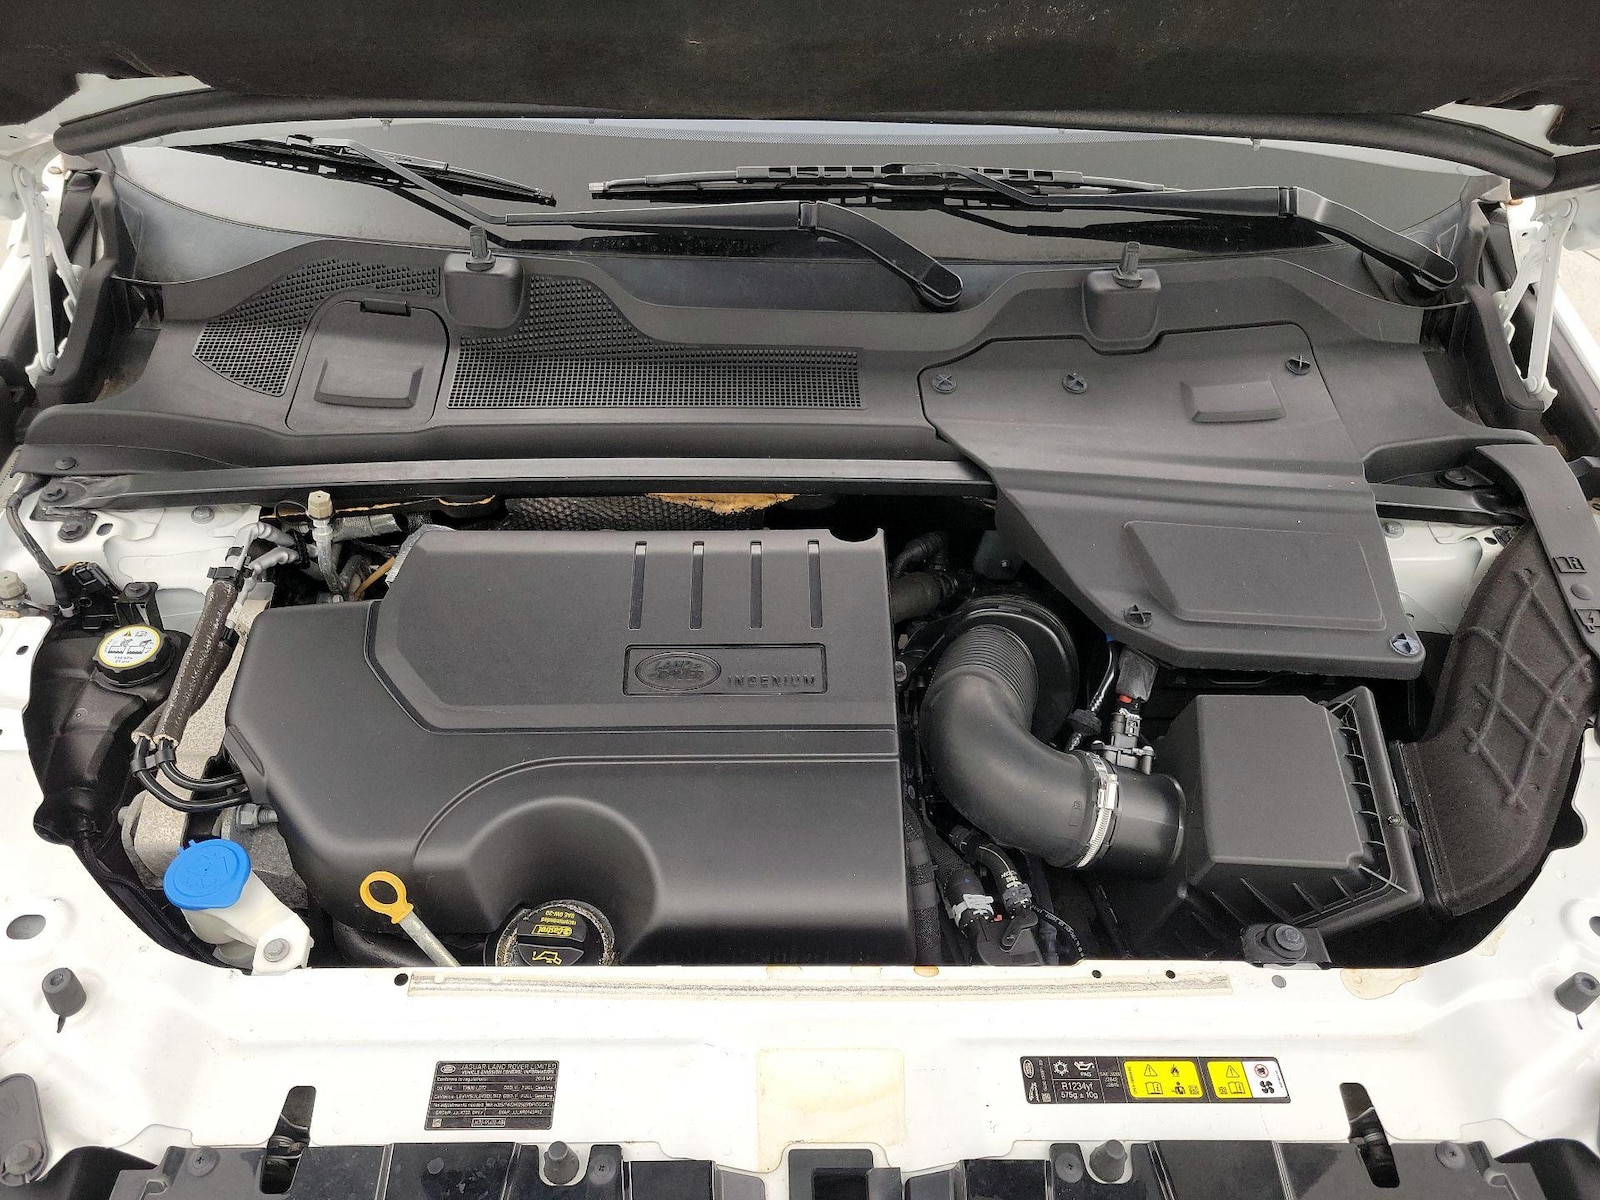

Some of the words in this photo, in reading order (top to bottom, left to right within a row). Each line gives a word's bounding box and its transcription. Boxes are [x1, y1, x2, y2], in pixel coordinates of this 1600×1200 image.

[727, 674, 816, 688] INGENIUM
[541, 916, 576, 925] recommended
[538, 926, 563, 935] Castrol
[1061, 1081, 1094, 1092] R1234yf
[1061, 1091, 1078, 1100] 575g
[1085, 1091, 1099, 1100] 10g
